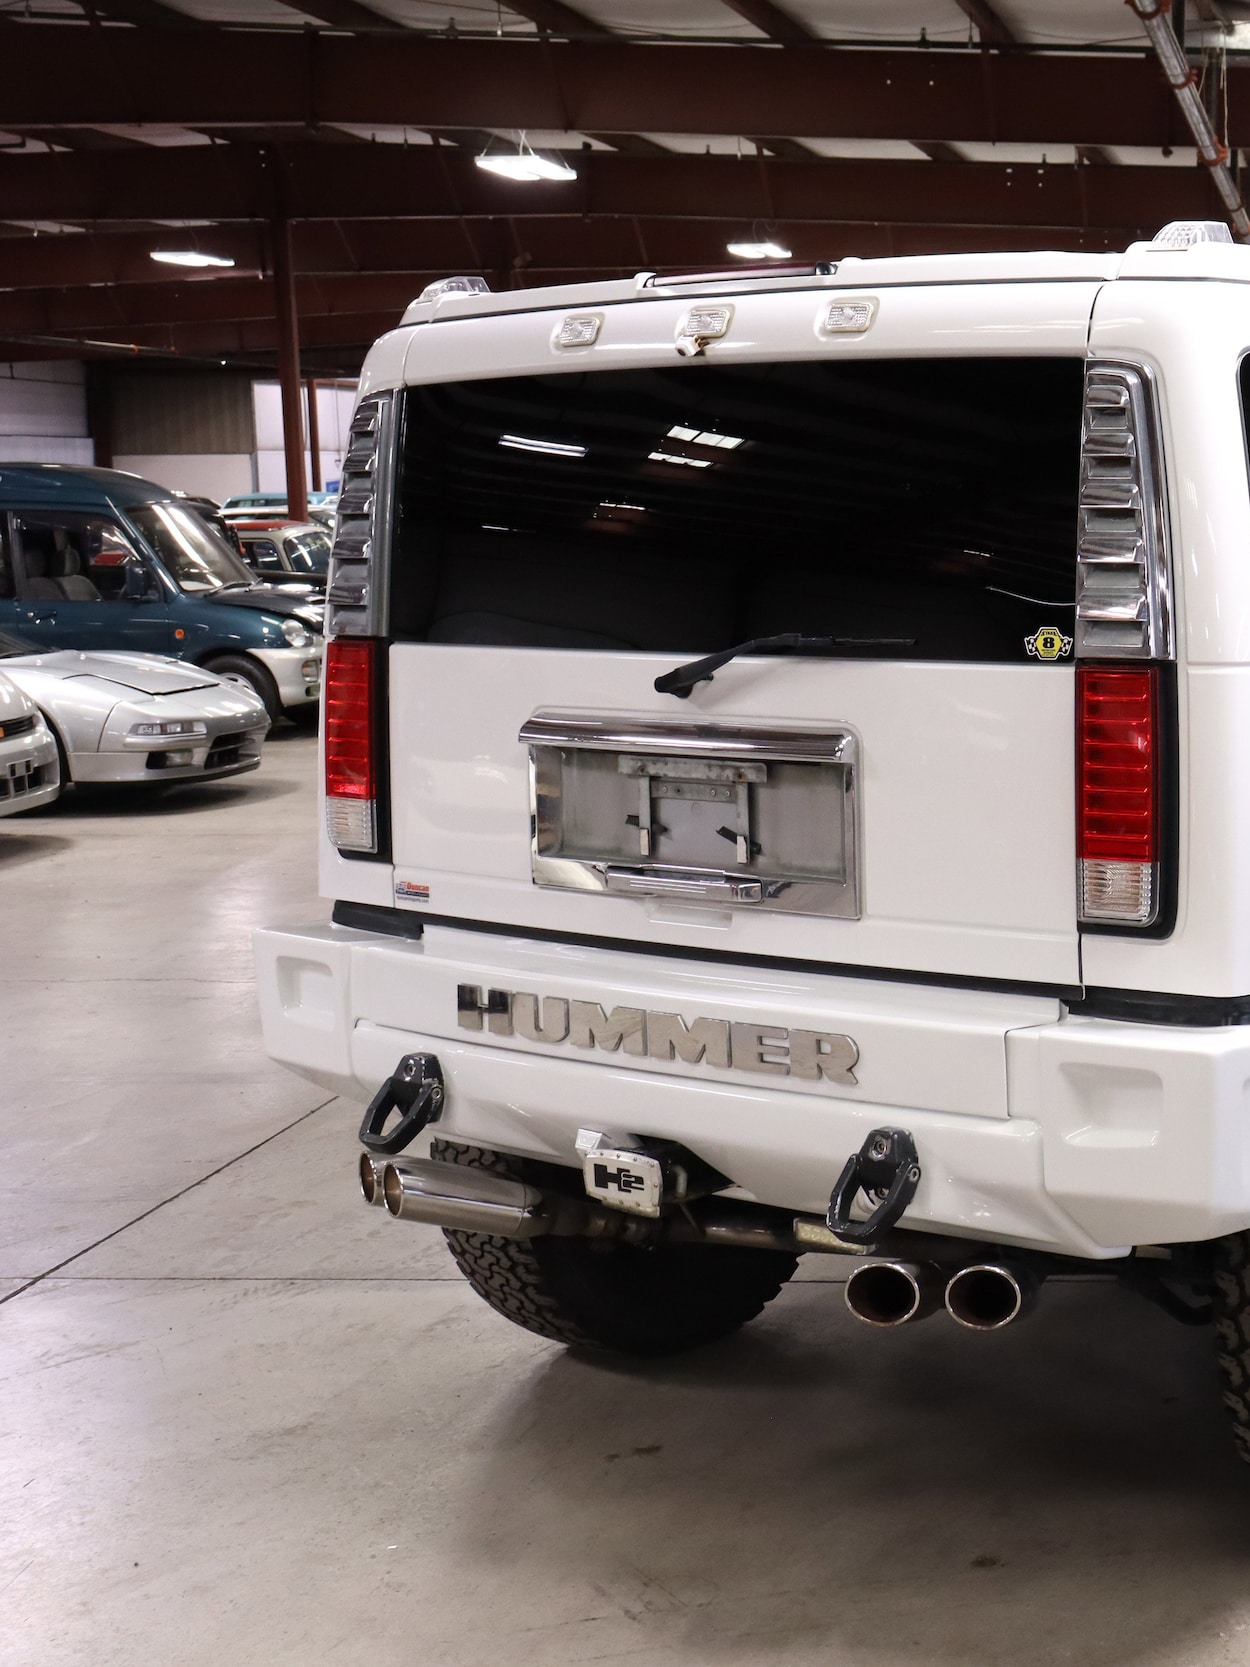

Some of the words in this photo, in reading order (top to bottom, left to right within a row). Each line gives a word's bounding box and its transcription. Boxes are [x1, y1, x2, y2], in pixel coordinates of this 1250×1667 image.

[1043, 637, 1055, 648] 8
[407, 882, 429, 892] Duncan
[457, 983, 860, 1085] HUMMER
[594, 1164, 645, 1193] H2
